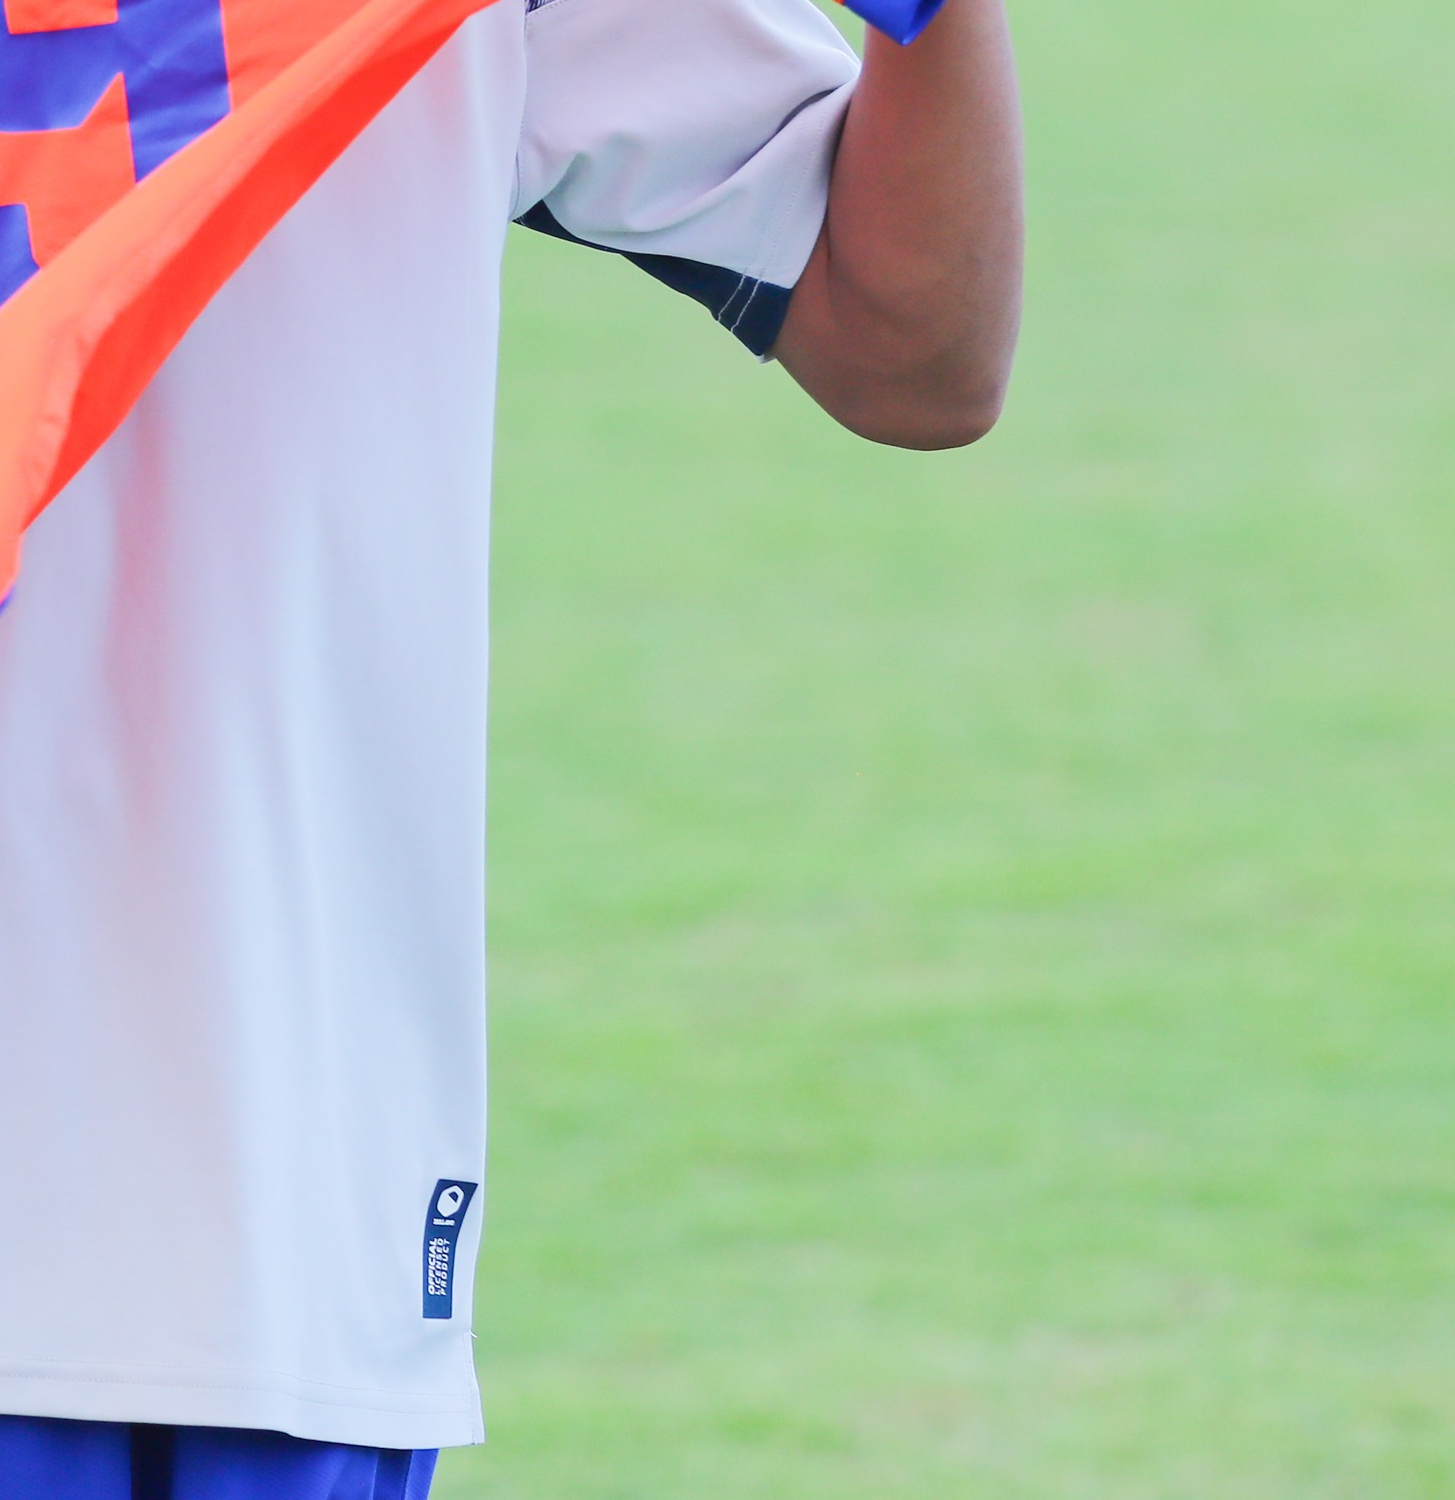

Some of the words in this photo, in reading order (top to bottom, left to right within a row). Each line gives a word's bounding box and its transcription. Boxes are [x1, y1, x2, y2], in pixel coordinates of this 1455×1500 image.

[428, 1238, 437, 1295] OFFICIAL
[435, 1238, 443, 1295] LICENSED
[440, 1239, 450, 1296] PRODUCT
